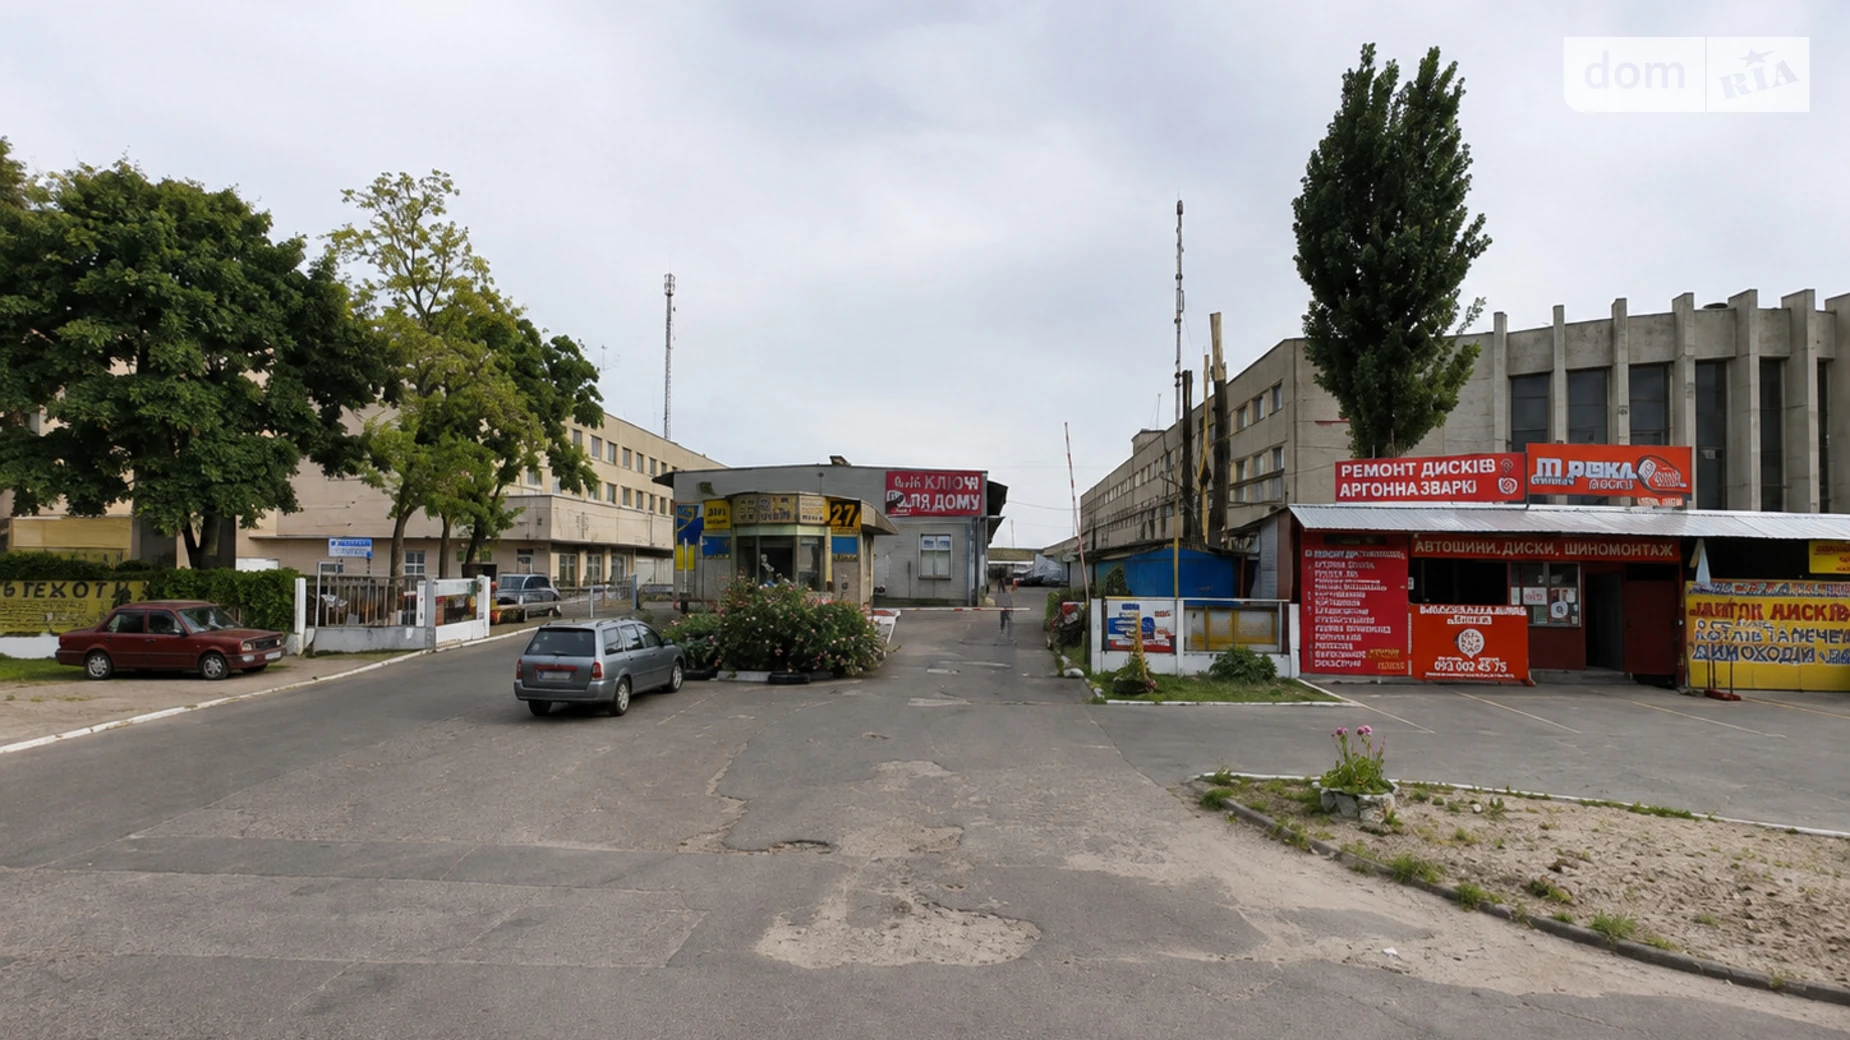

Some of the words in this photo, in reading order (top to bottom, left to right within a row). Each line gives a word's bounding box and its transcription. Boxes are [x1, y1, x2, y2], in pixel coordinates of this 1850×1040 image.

[1341, 461, 1416, 478] РЕМОНТ
[1339, 481, 1419, 498] АРГОННА
[933, 494, 980, 511] ДОМУ
[832, 503, 856, 526] 27
[1564, 543, 1673, 557] ШИНОМОНТАЖ
